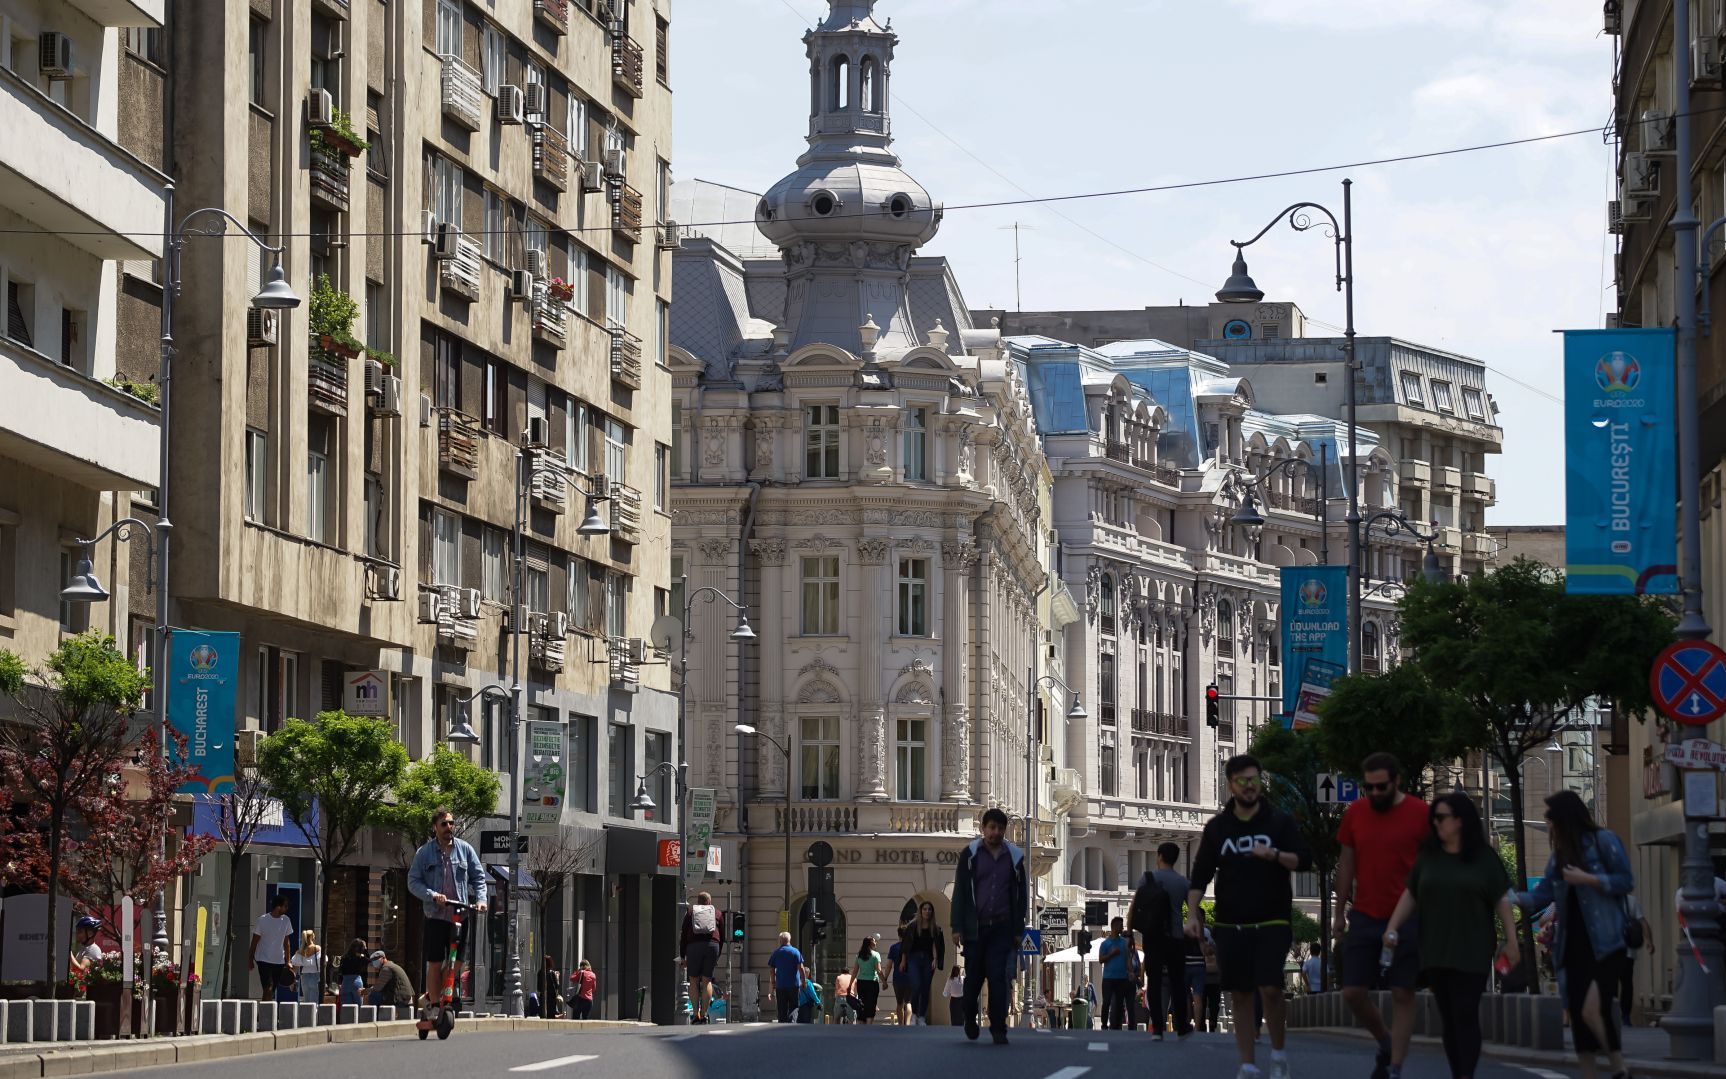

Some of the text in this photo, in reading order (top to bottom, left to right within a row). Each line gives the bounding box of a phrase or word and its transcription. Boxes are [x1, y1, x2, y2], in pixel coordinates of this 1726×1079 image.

[1290, 621, 1340, 631] DOWNLOAD
[1290, 632, 1327, 641] THE APP
[194, 687, 209, 757] BUCHAREST
[1342, 782, 1353, 798] P
[875, 850, 929, 863] HOTEL
